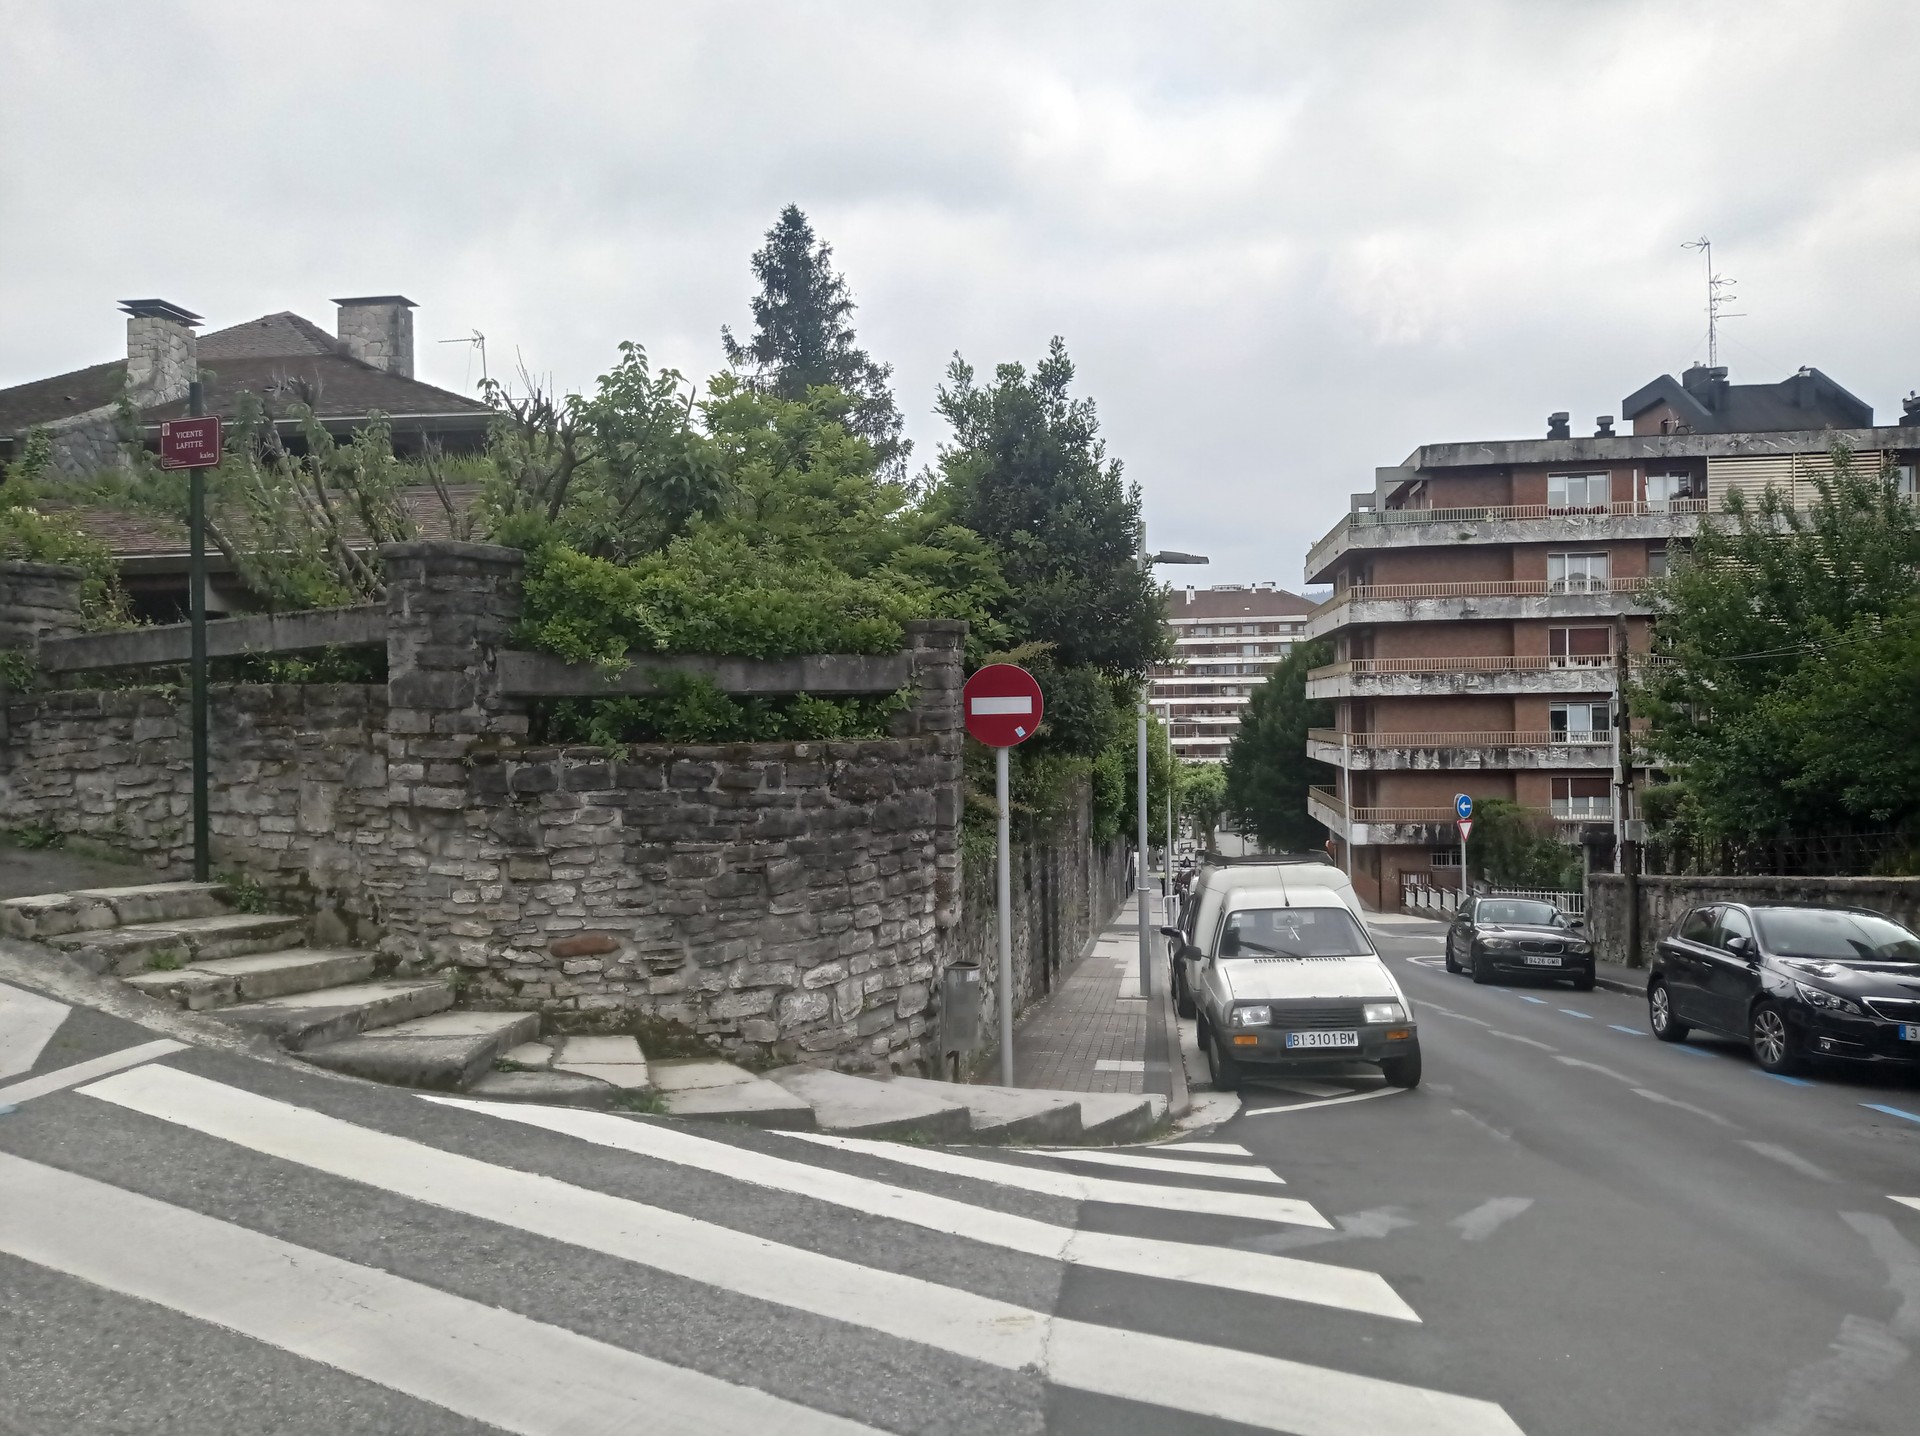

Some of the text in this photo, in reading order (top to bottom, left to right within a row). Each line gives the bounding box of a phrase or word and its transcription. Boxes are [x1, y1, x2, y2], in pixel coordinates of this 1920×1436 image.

[176, 430, 203, 438] VICENTE
[176, 440, 203, 449] LAFITTE
[1910, 1027, 1917, 1039] 3
